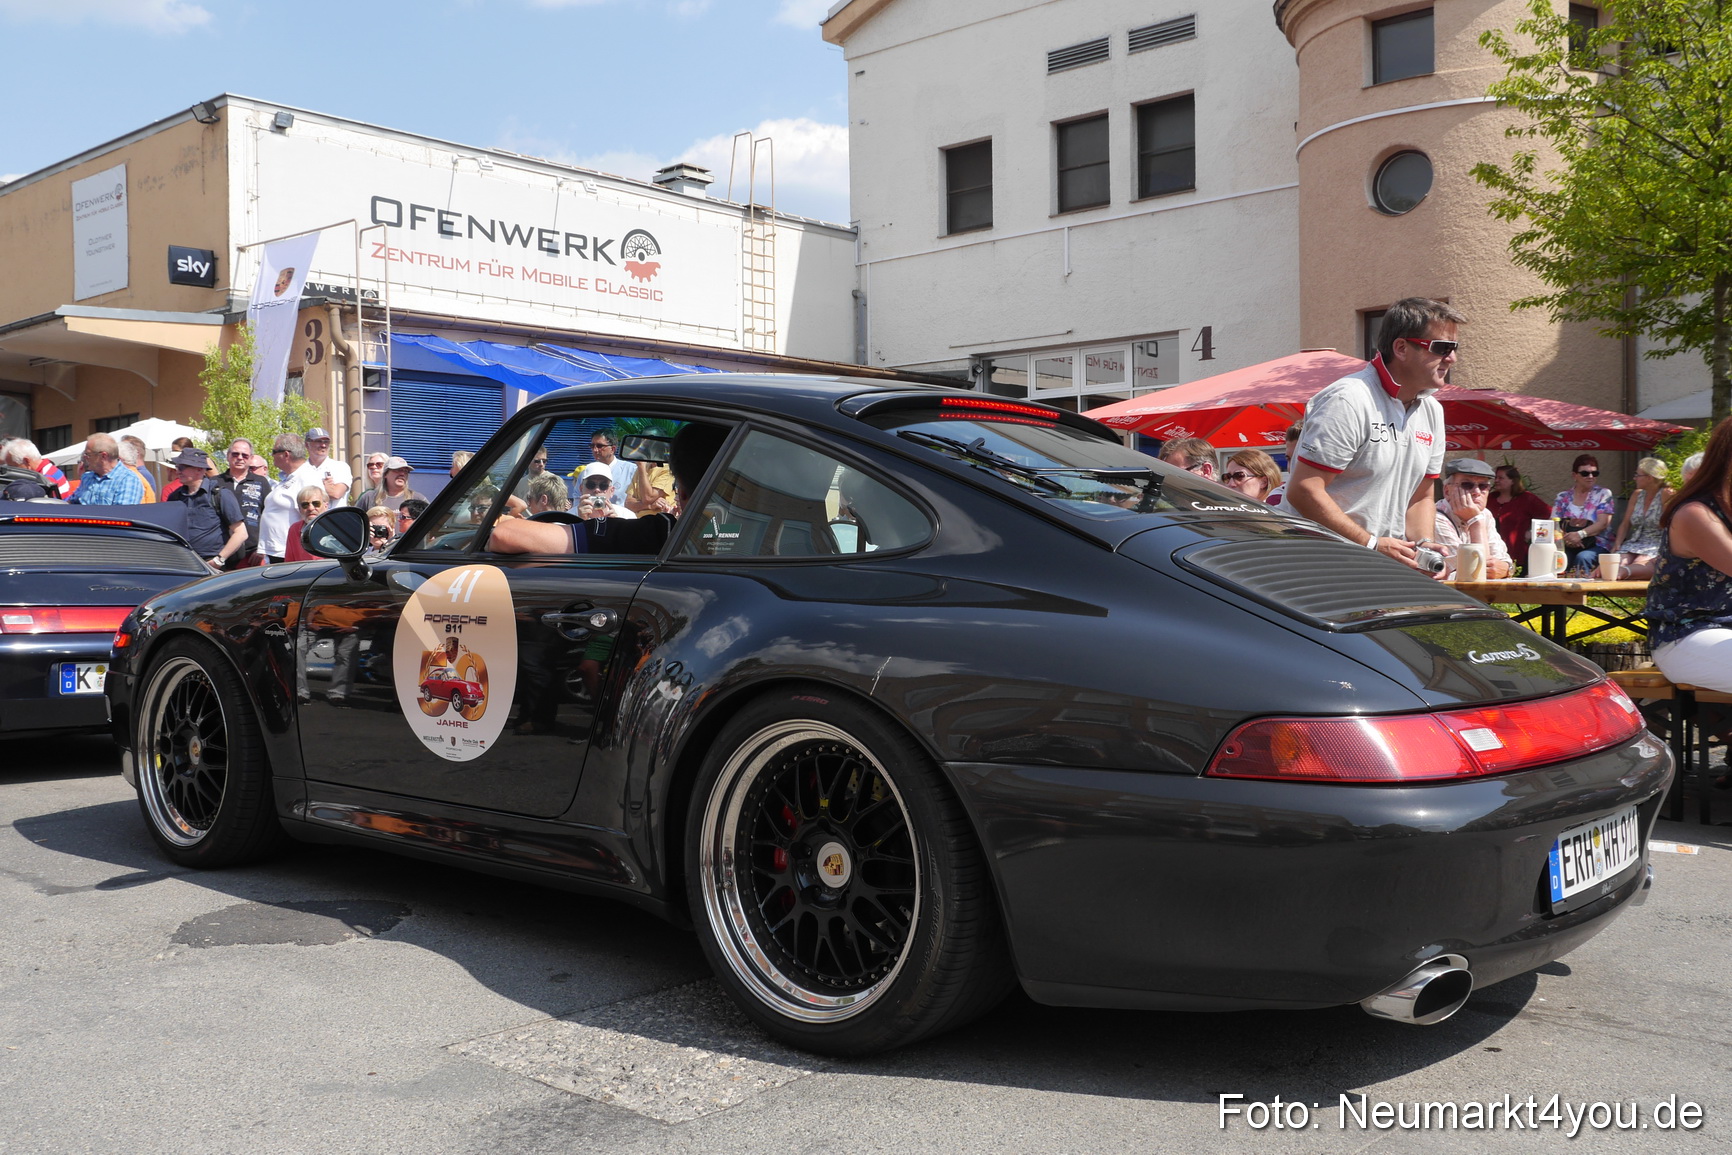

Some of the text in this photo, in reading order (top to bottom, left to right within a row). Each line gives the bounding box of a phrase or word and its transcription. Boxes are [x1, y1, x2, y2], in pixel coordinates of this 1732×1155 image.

[76, 191, 115, 212] OFENWERK
[371, 195, 617, 266] OFENWERK
[177, 256, 210, 278] sky
[371, 242, 663, 302] ZENTRUM FÜR MOBILE CLASSIC
[305, 319, 325, 365] 3
[1191, 325, 1216, 361] 4
[1369, 422, 1398, 443] 351
[1191, 502, 1269, 514] Carrera Cup
[447, 570, 484, 603] 41
[423, 614, 488, 625] PORSCHE
[445, 624, 462, 633] 911
[1468, 650, 1521, 663] Carrera
[77, 667, 91, 689] K
[436, 719, 469, 729] JAHRE
[1561, 809, 1638, 889] ERH WH 911
[1552, 875, 1558, 889] D
